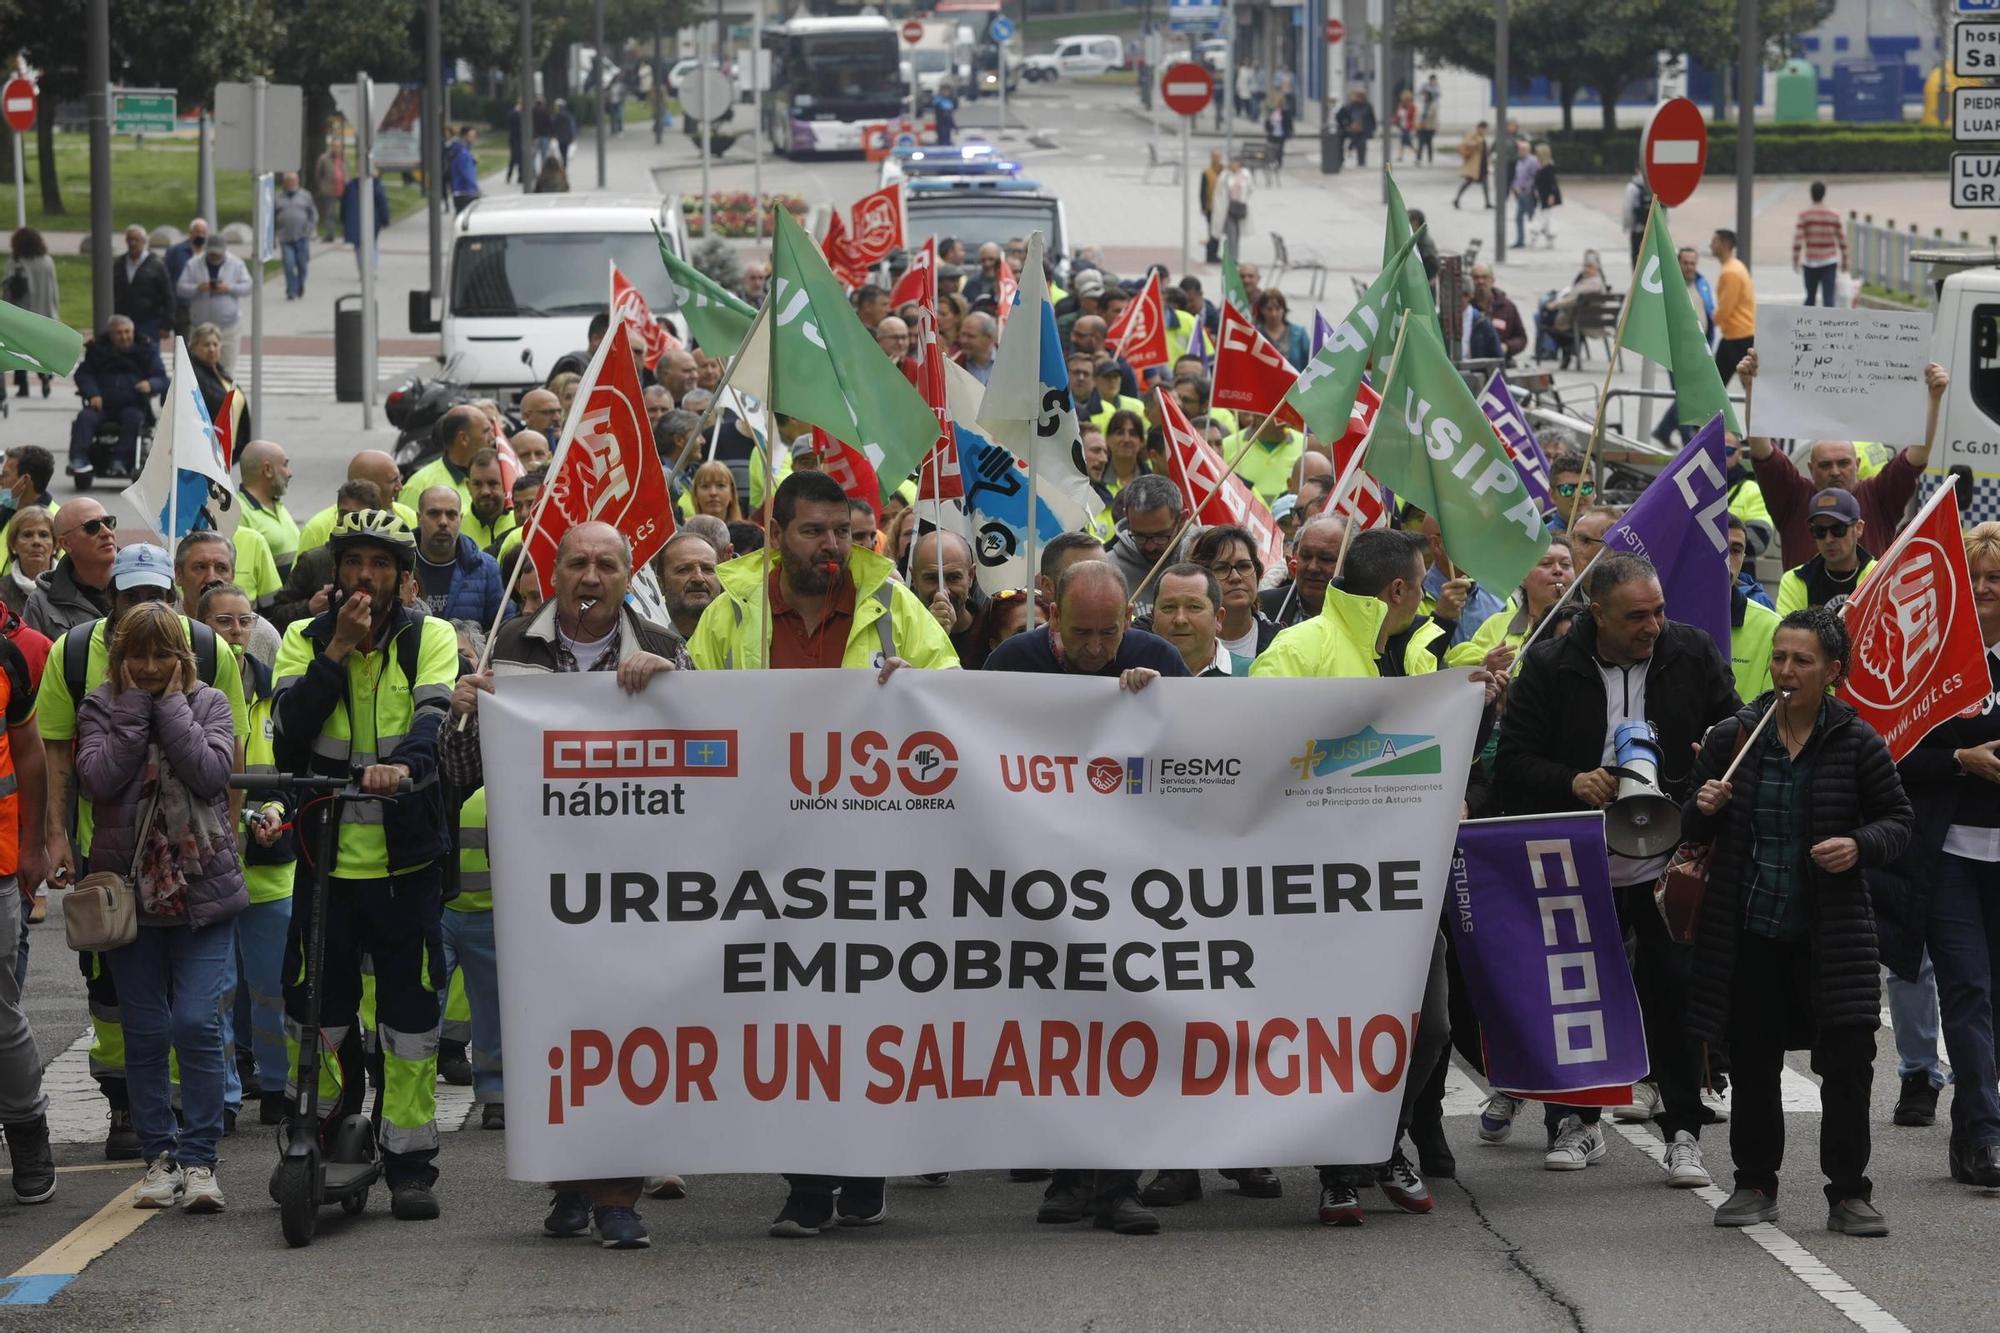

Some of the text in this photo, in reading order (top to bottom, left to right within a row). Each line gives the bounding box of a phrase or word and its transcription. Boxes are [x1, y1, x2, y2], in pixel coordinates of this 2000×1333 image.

[1966, 29, 2000, 45] hos
[1405, 386, 1541, 543] USIPA
[1888, 551, 1940, 676] UGT
[553, 739, 675, 768] CCOO
[789, 730, 959, 797] USO
[1332, 738, 1398, 760] USIPA
[1000, 754, 1078, 793] UGT
[1160, 758, 1241, 776] FeSMC
[1199, 777, 1236, 785] Movilidad
[543, 782, 685, 817] hábitat
[789, 796, 956, 811] UNIÓN SINDICAL OBRERA
[1306, 795, 1422, 809] del Principado de Asturias
[1312, 786, 1324, 795] de
[1326, 785, 1373, 795] Sindicatos
[1374, 783, 1443, 794] Independientes
[550, 860, 1424, 930] URBASER NOS QUIERE
[723, 939, 1256, 993] EMPOBRECER
[1525, 838, 1608, 1066] CCOO
[548, 1026, 719, 1125] ¡POR
[742, 1023, 841, 1102] UN
[864, 1019, 1159, 1105] SALARIO
